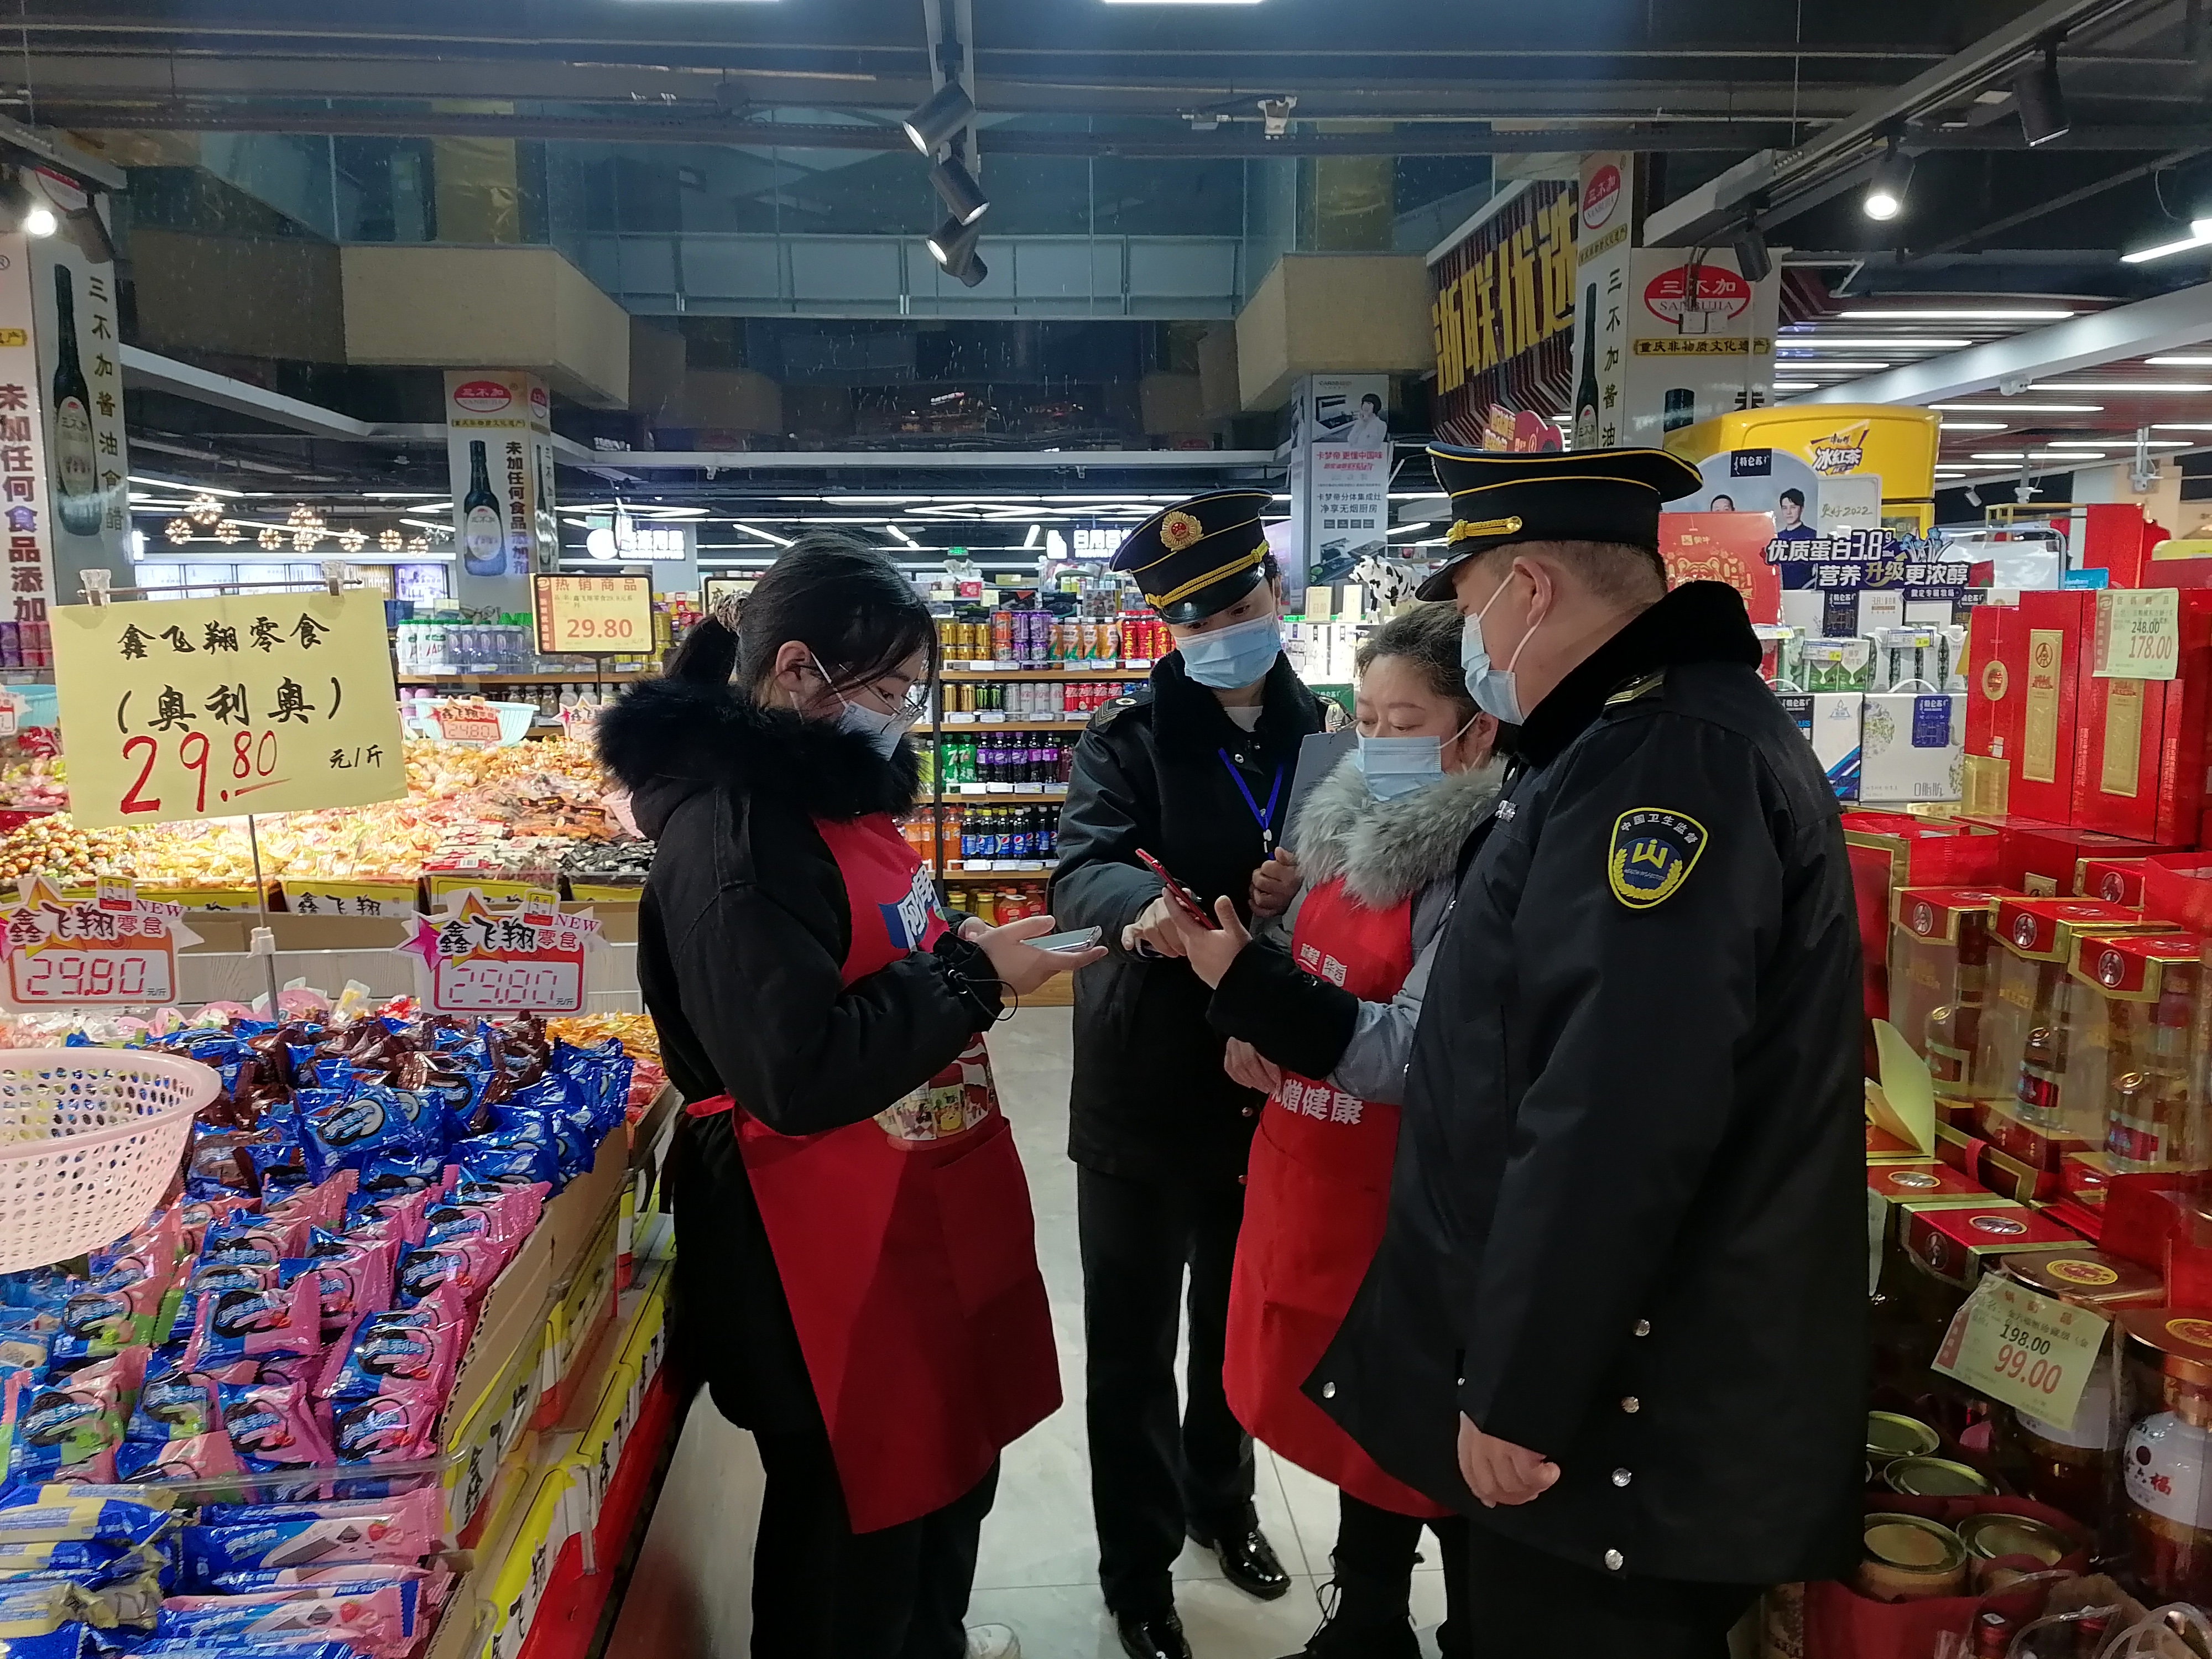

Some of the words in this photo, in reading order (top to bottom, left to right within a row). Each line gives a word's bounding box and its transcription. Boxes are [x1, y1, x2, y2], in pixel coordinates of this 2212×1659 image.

[1588, 175, 1616, 204] 三不加
[1812, 447, 1861, 471] 冰红茶
[1320, 504, 1378, 514] 净享无烟厨房
[556, 578, 637, 591] 热销商品
[117, 613, 330, 660] 鑫飞翔零食
[567, 619, 633, 638] 29.80
[2131, 622, 2160, 633] 248.00
[2129, 635, 2172, 659] 178.00
[330, 747, 383, 769] 元/斤
[121, 730, 279, 815] 29.80
[1620, 813, 1698, 843] 中国卫生监督
[137, 900, 183, 917] NEW
[298, 891, 381, 916] 鑫飞翔
[9, 902, 114, 942] 鑫飞翔
[117, 915, 163, 935] 零食
[440, 915, 535, 953] 鑫飞翔
[554, 914, 599, 932] NEW
[538, 930, 577, 948] 零食
[1999, 1324, 2051, 1355] 198.00
[1994, 1344, 2063, 1394] 99.00
